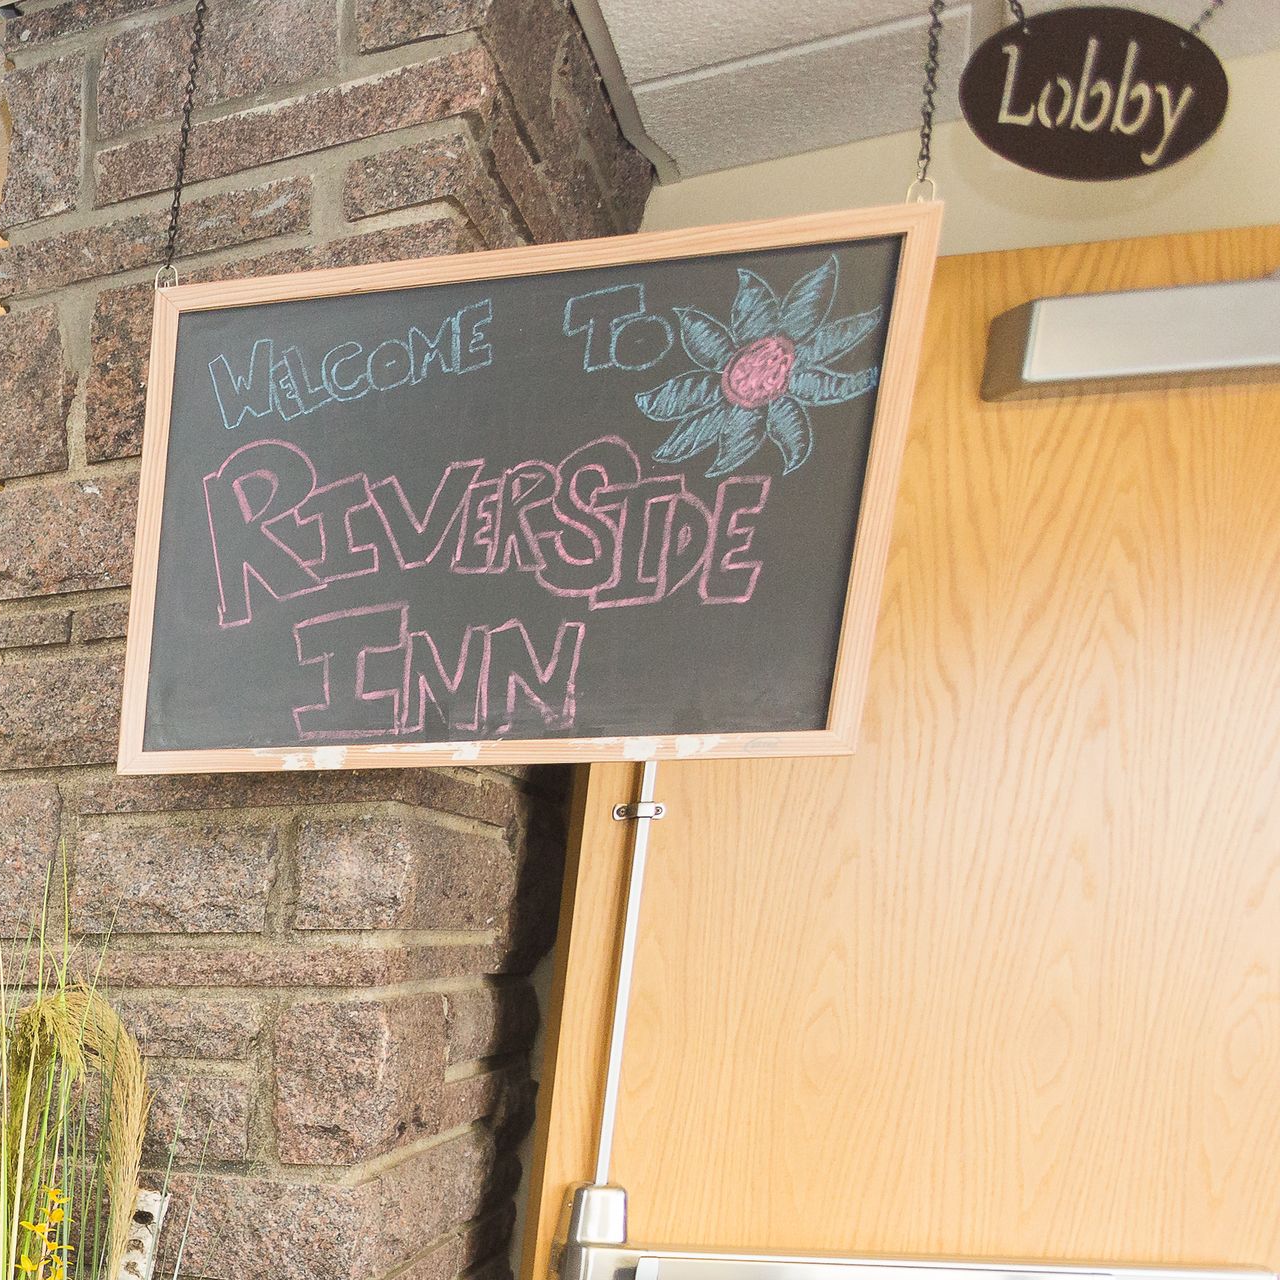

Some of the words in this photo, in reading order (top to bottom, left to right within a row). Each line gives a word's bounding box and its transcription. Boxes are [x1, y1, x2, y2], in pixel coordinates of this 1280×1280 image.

[997, 37, 1194, 166] Lobby
[206, 297, 494, 430] WELCOME
[562, 282, 675, 373] TO
[201, 434, 774, 629] RIVERSIDE
[291, 601, 587, 741] INN
